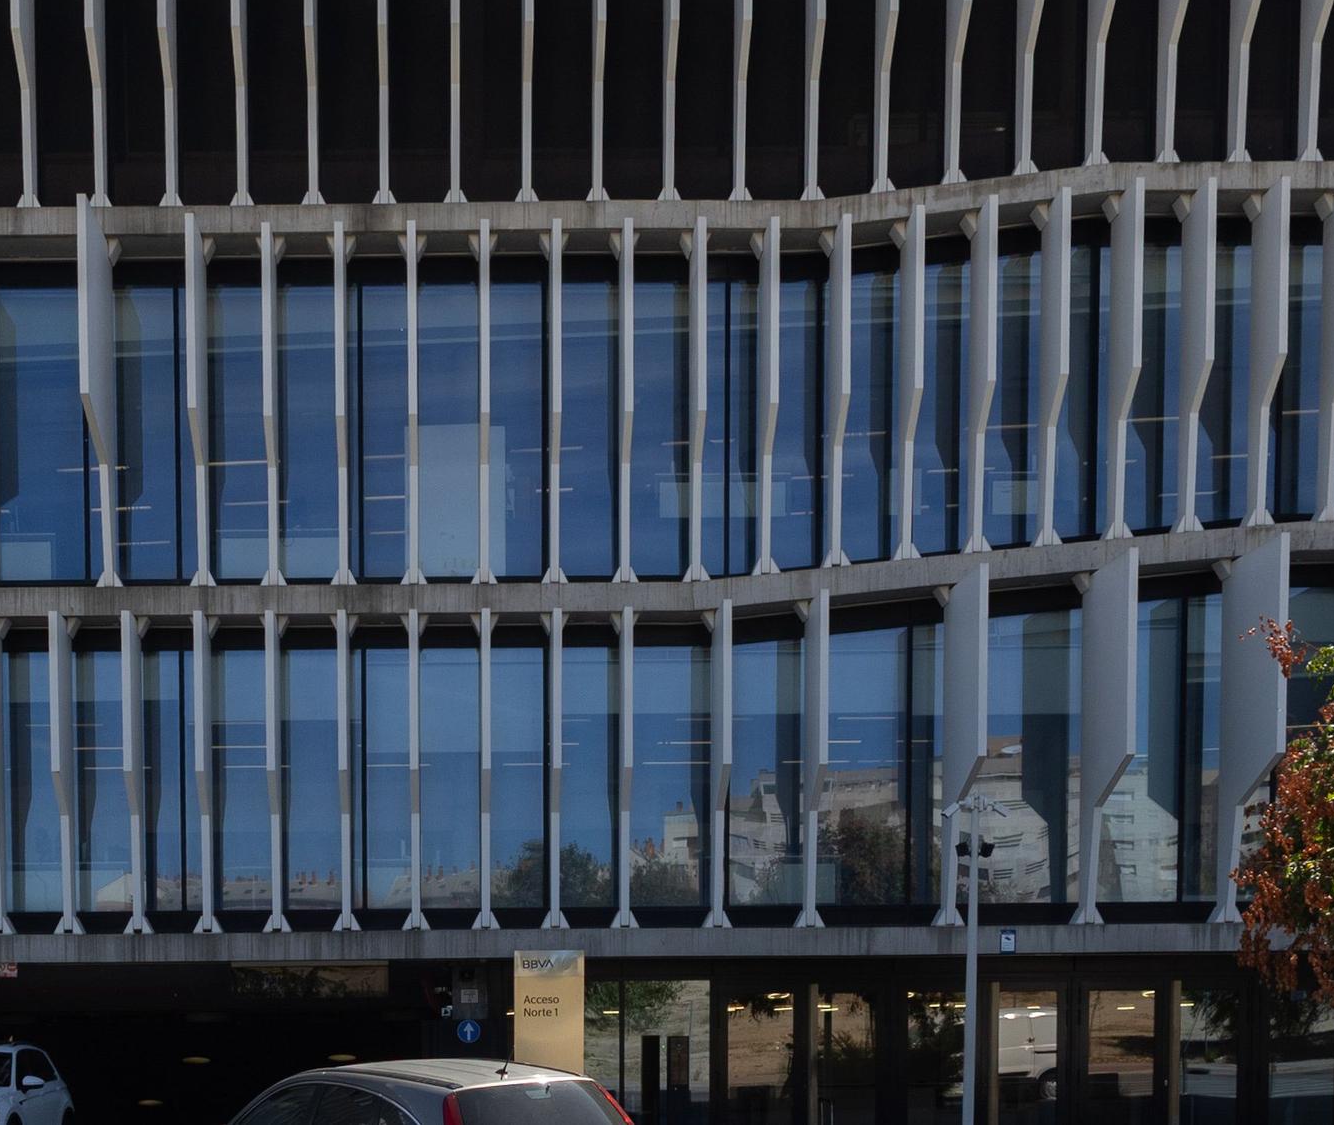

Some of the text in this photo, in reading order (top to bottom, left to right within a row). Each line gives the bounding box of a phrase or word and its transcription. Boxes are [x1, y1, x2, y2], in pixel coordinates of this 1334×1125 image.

[522, 959, 554, 969] BBVA
[523, 995, 560, 1004] Acceso
[523, 1008, 553, 1017] Norte
